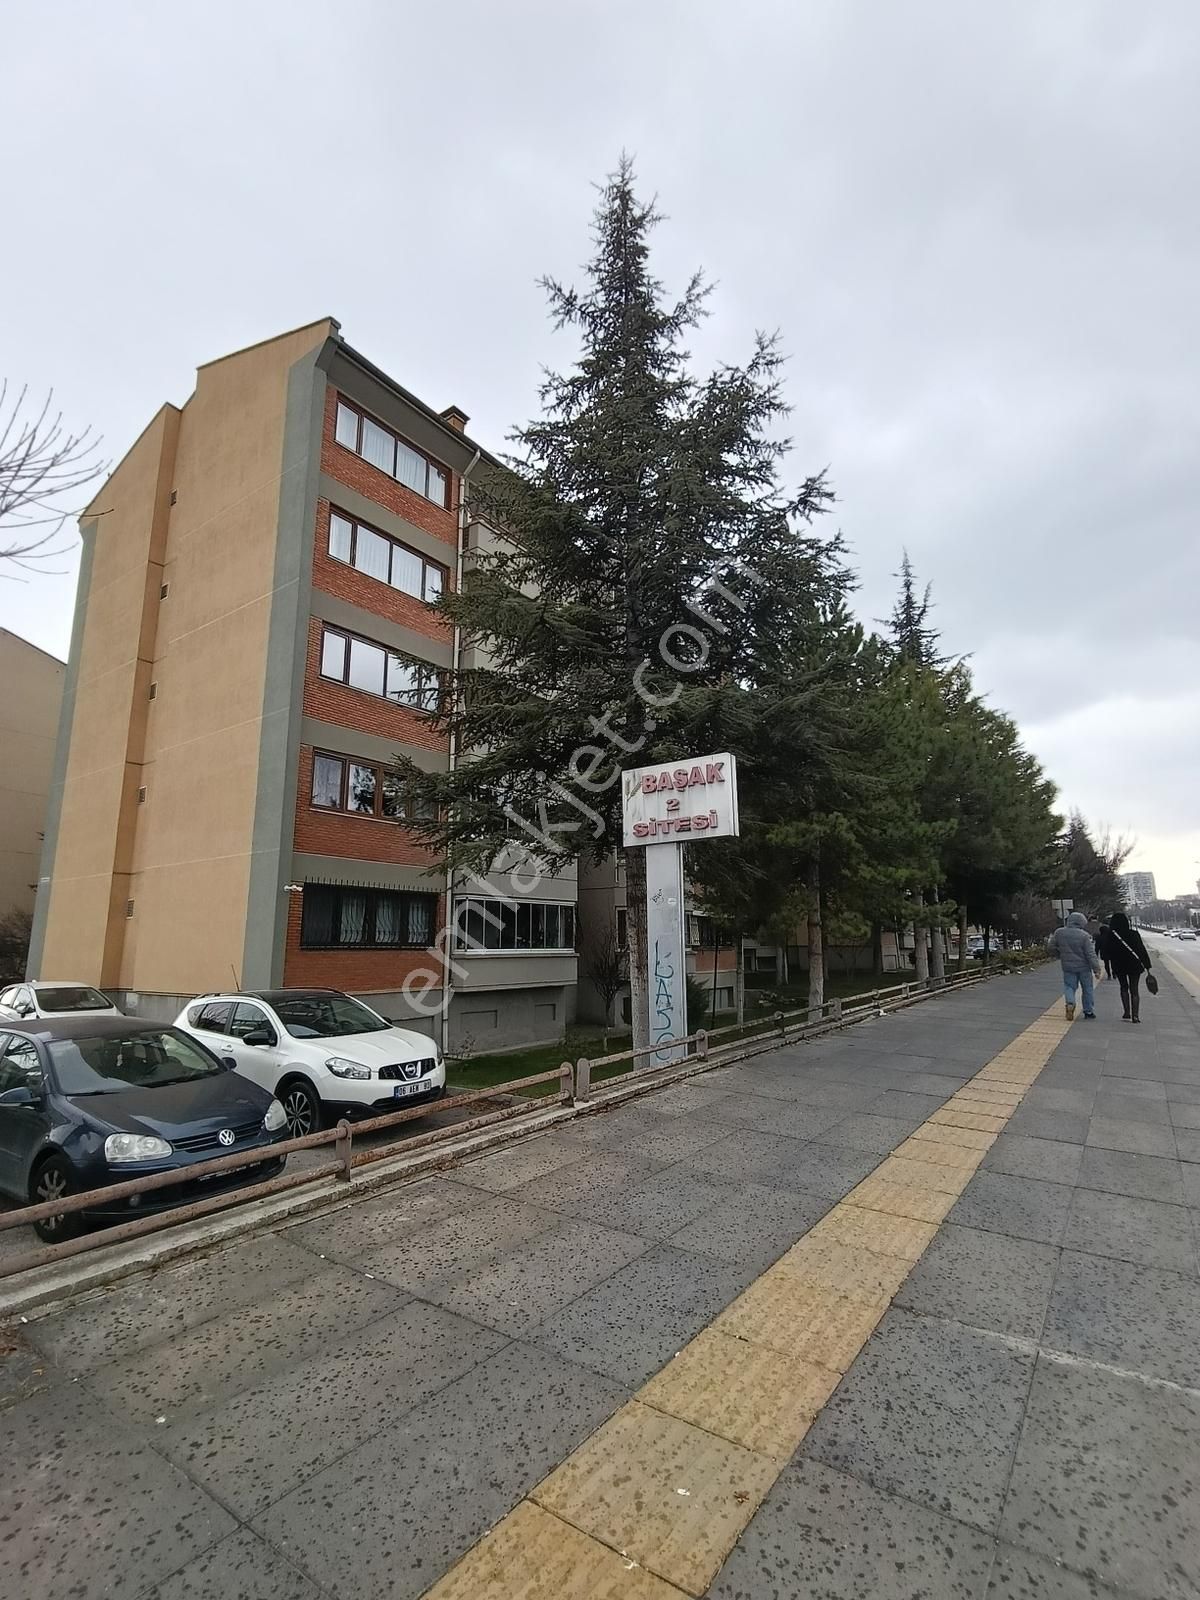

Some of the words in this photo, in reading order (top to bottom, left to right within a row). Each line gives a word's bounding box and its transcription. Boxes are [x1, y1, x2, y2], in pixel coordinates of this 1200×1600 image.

[642, 762, 725, 794] BAŞAK
[666, 798, 680, 812] 2
[633, 809, 718, 837] SİTESİ
